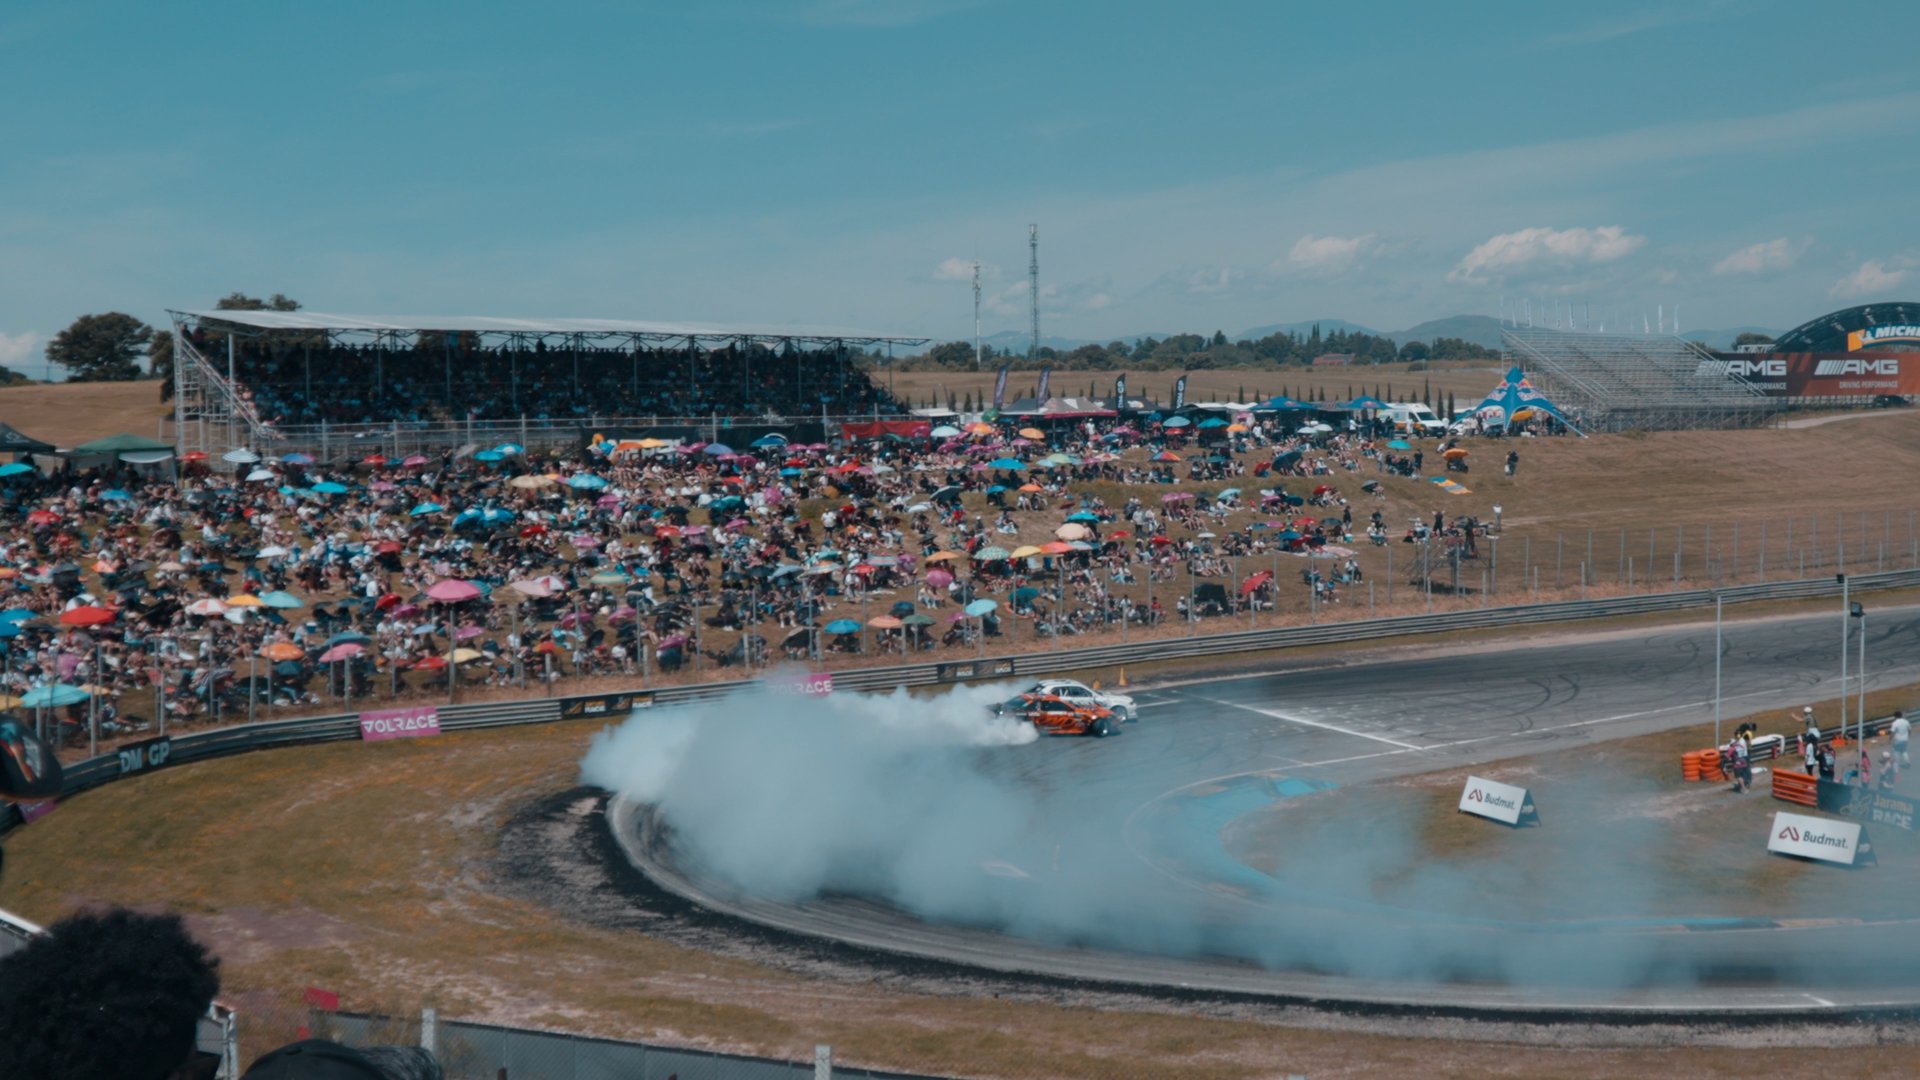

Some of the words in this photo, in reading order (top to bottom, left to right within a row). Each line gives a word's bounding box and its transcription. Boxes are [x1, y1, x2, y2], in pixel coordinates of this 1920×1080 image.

[1724, 360, 1787, 376] AMG
[1840, 359, 1898, 375] AMG
[361, 714, 439, 733] VOLRACE
[148, 741, 170, 766] GP
[1873, 807, 1913, 831] RACE
[1803, 831, 1849, 849] Budmat.
